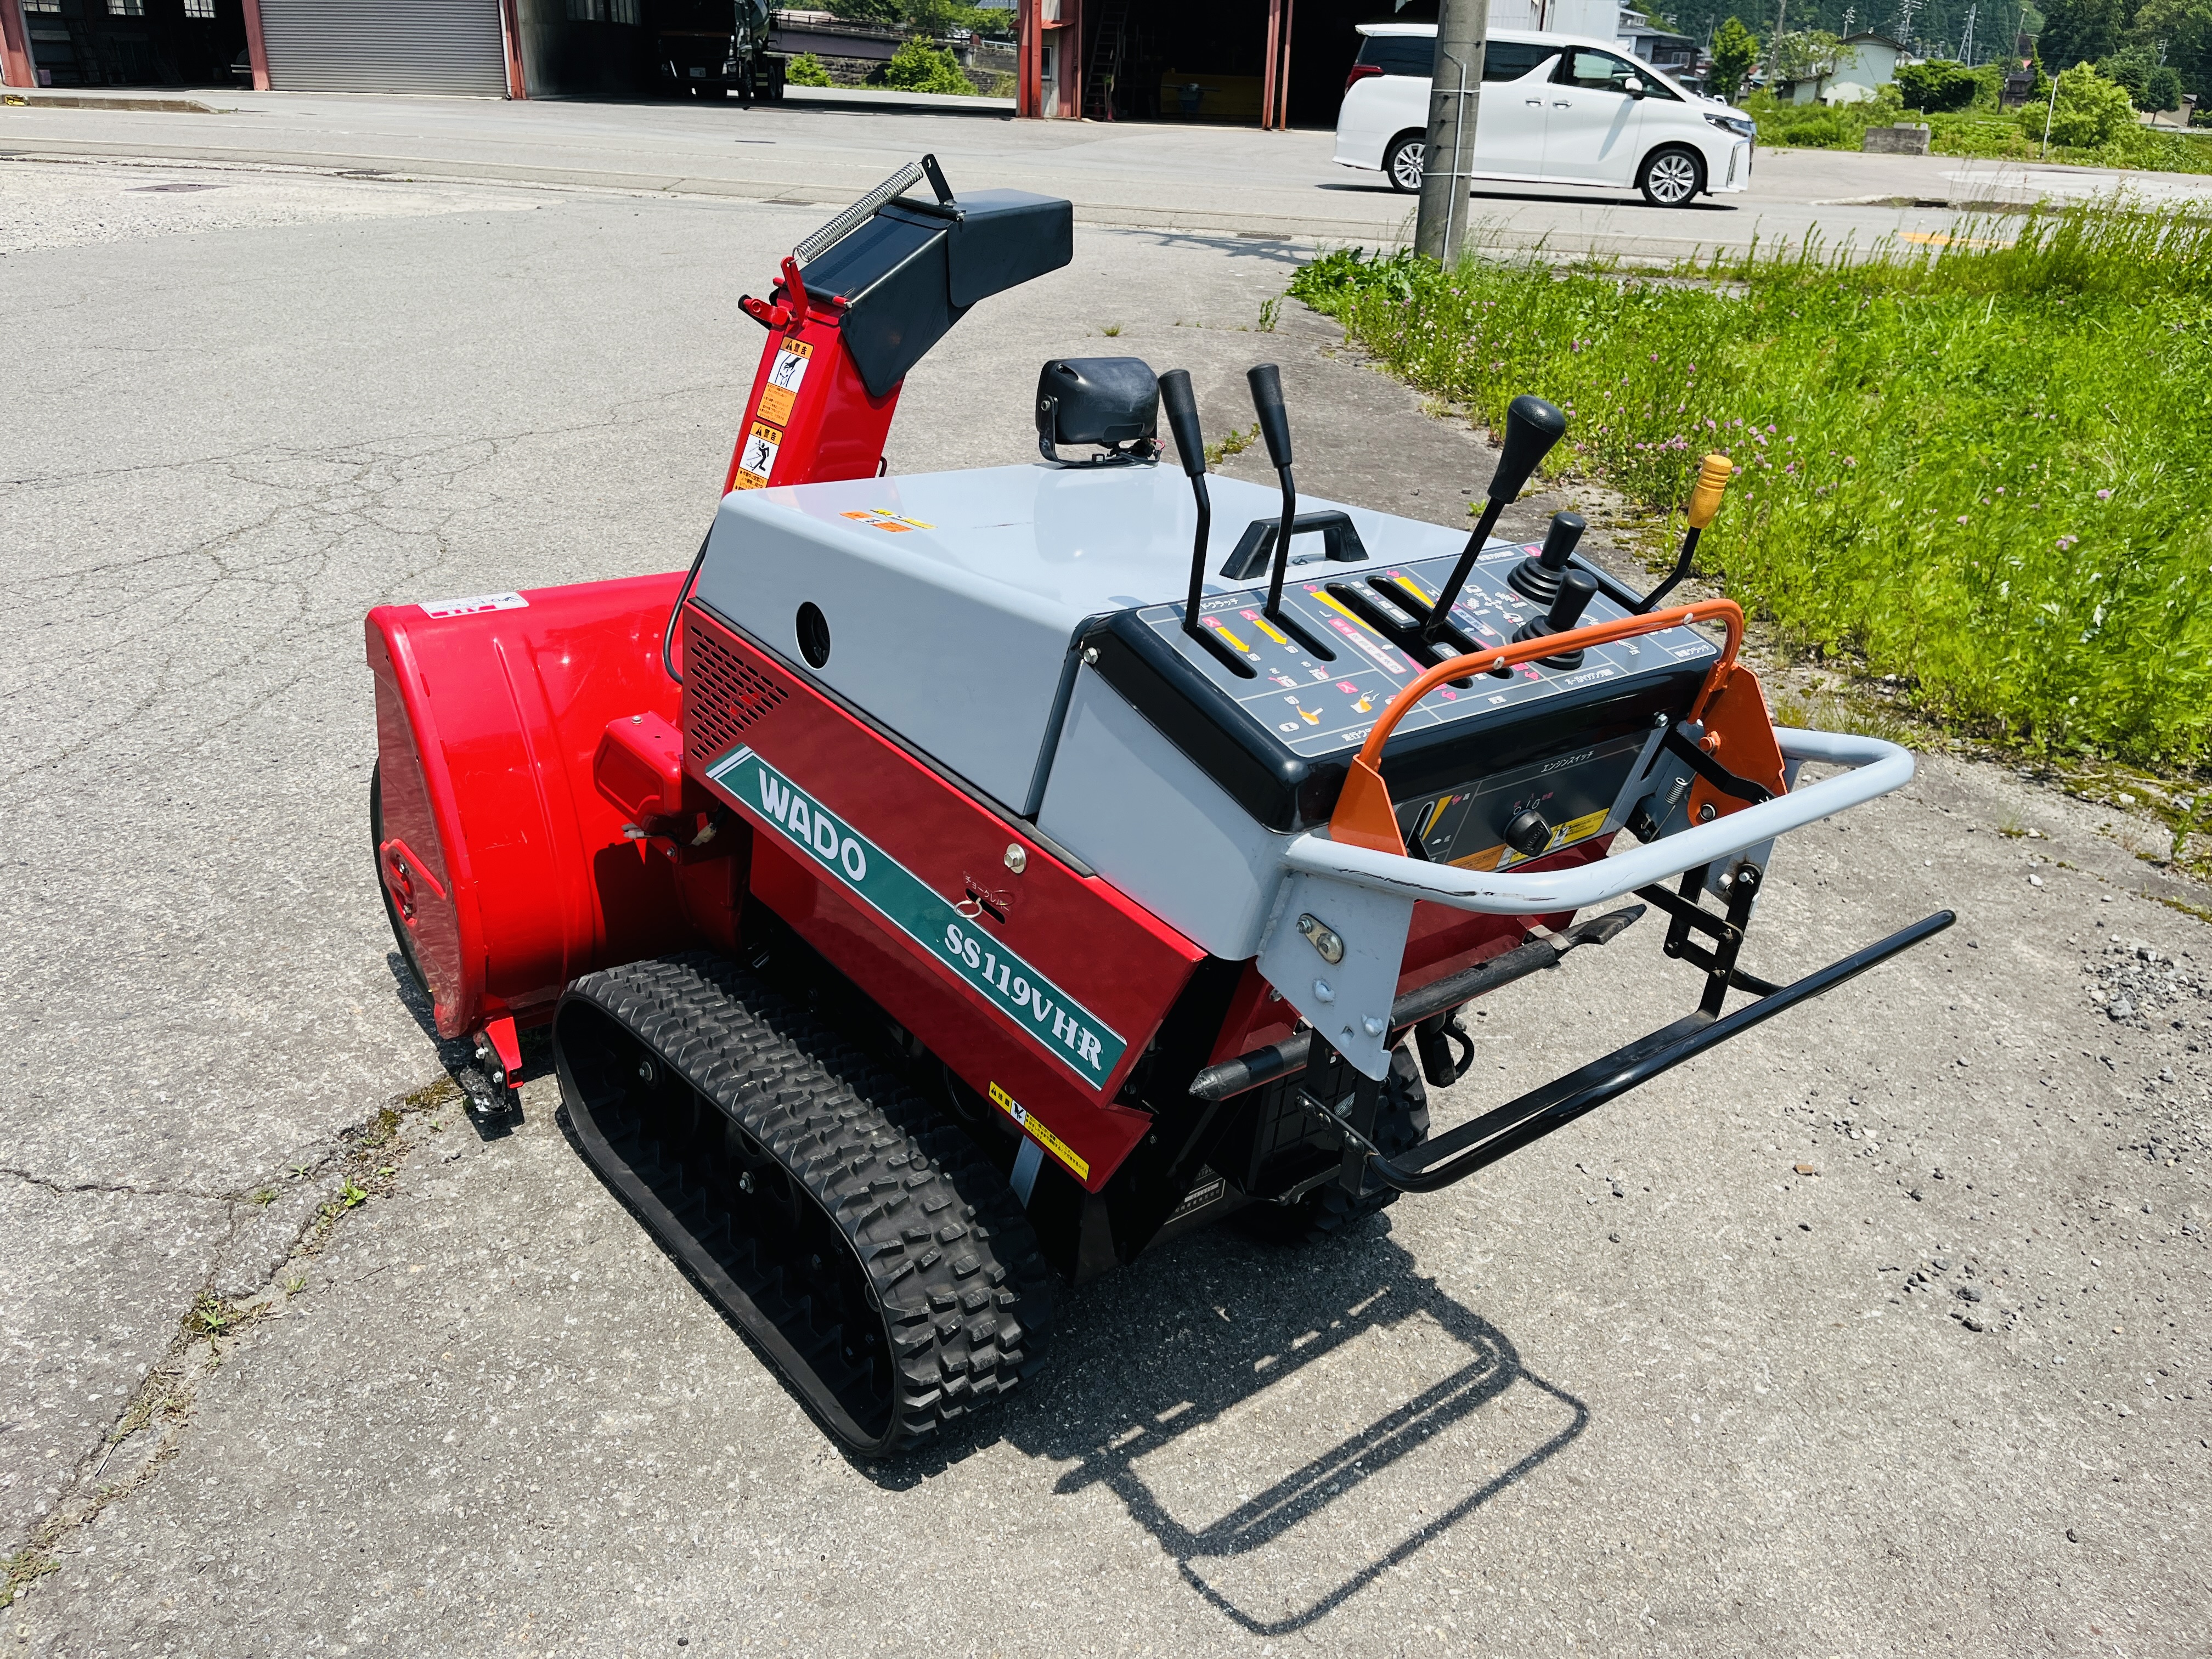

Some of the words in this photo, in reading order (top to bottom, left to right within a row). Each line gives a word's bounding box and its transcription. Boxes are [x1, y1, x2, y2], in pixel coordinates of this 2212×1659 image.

[763, 428, 777, 442] 警告
[1541, 750, 1594, 773] エンジンスイッチ
[759, 768, 867, 882] WADO
[965, 875, 1009, 911] チョークレバー
[944, 924, 1102, 1071] SS119VHR
[998, 1092, 1010, 1107] 注意
